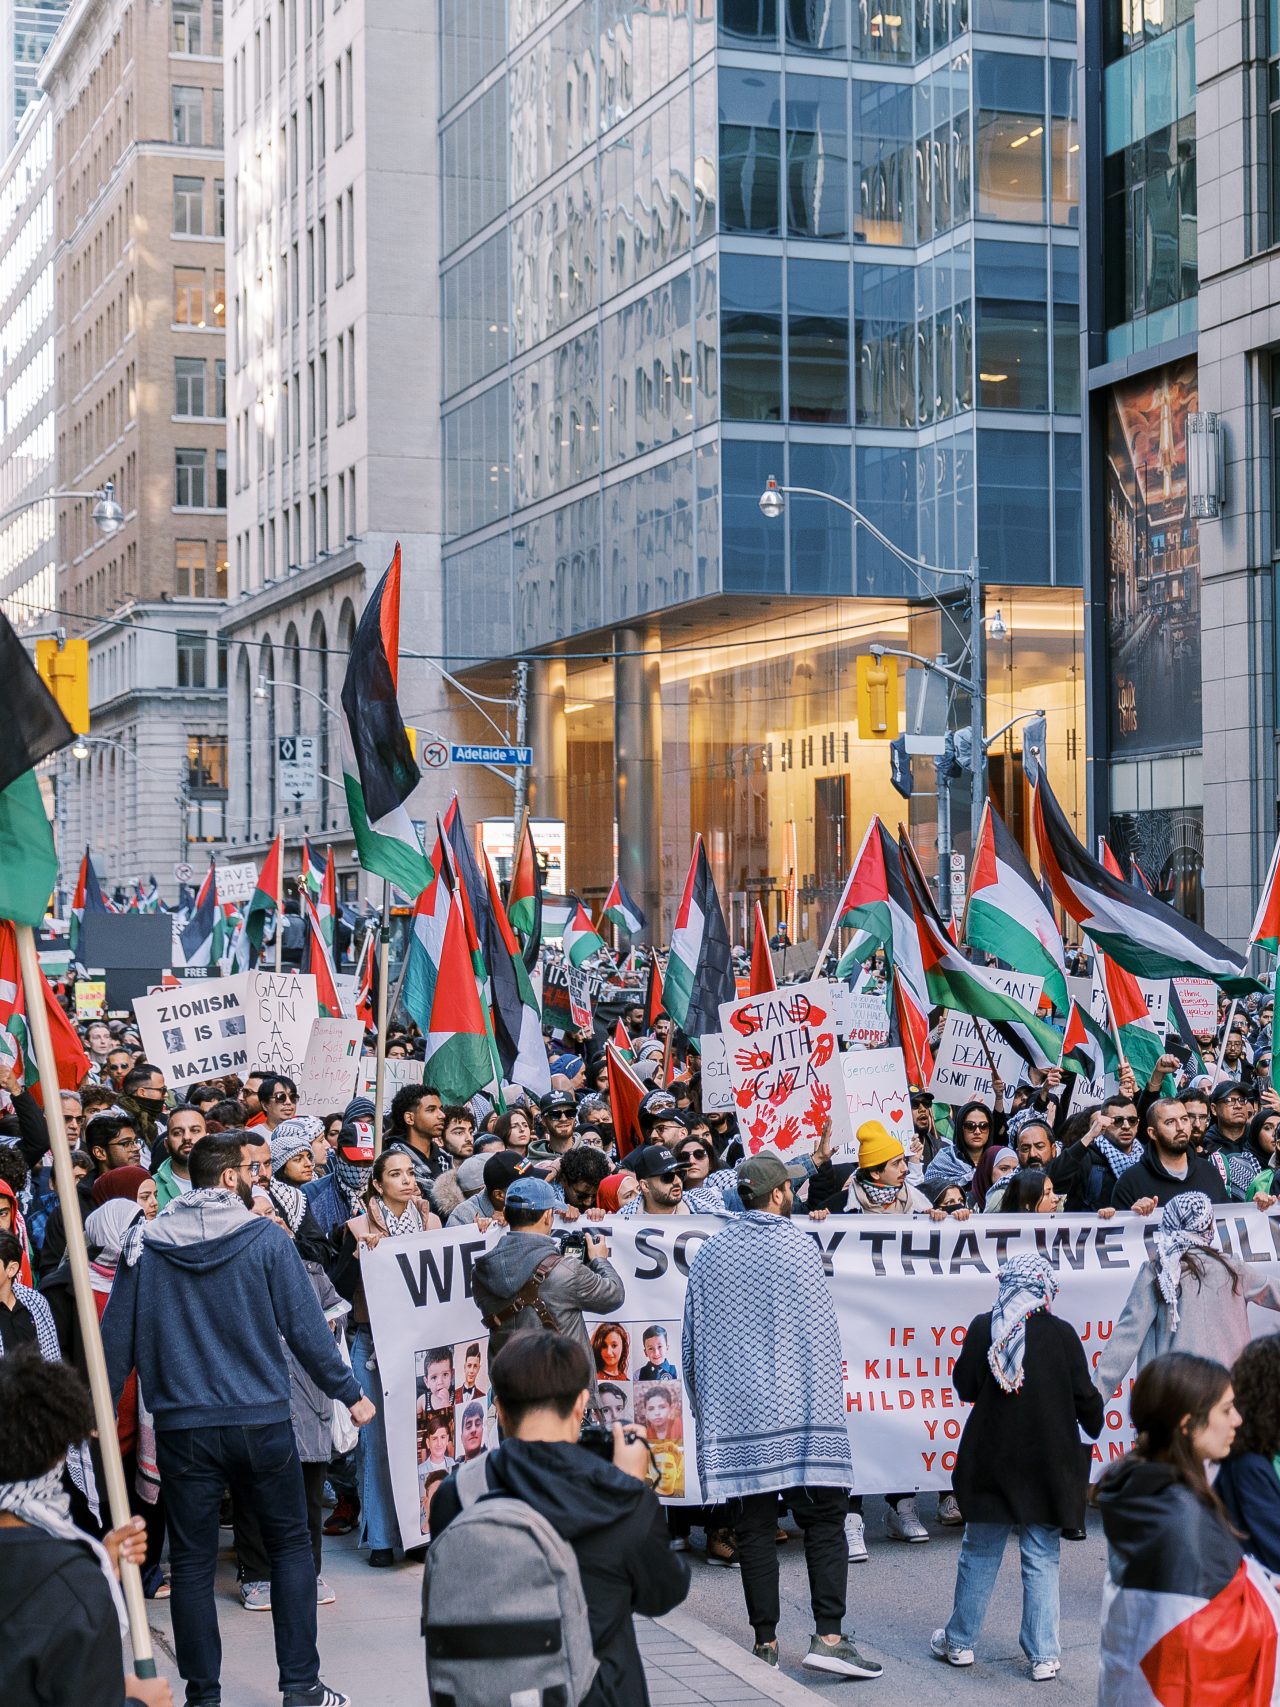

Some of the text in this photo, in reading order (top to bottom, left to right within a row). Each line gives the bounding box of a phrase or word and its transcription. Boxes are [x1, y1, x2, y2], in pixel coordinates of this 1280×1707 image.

[456, 747, 507, 761] Adelaide
[516, 749, 528, 762] W
[184, 967, 208, 977] FREE
[255, 973, 304, 999] GAZA
[157, 992, 240, 1023] ZIONISM
[258, 998, 296, 1023] IS IN
[737, 993, 811, 1037] STAND
[195, 1024, 213, 1042] IS
[270, 1020, 284, 1042] A
[257, 1041, 294, 1064] GAS
[754, 1026, 813, 1067] WITH
[172, 1049, 248, 1080] NAZISM
[366, 1059, 405, 1081] LNG
[843, 1056, 897, 1079] Genocide
[754, 1062, 820, 1100] GAZA
[936, 1067, 948, 1083] IS
[951, 1071, 972, 1087] NOT
[1003, 1083, 1017, 1100] ND
[859, 1228, 1021, 1277] THAT
[1034, 1226, 1131, 1270] WE
[890, 1327, 915, 1347] IF
[931, 1326, 967, 1347] YO
[846, 1387, 975, 1413] HILDRE
[924, 1418, 961, 1441] YO
[921, 1450, 957, 1472] YO
